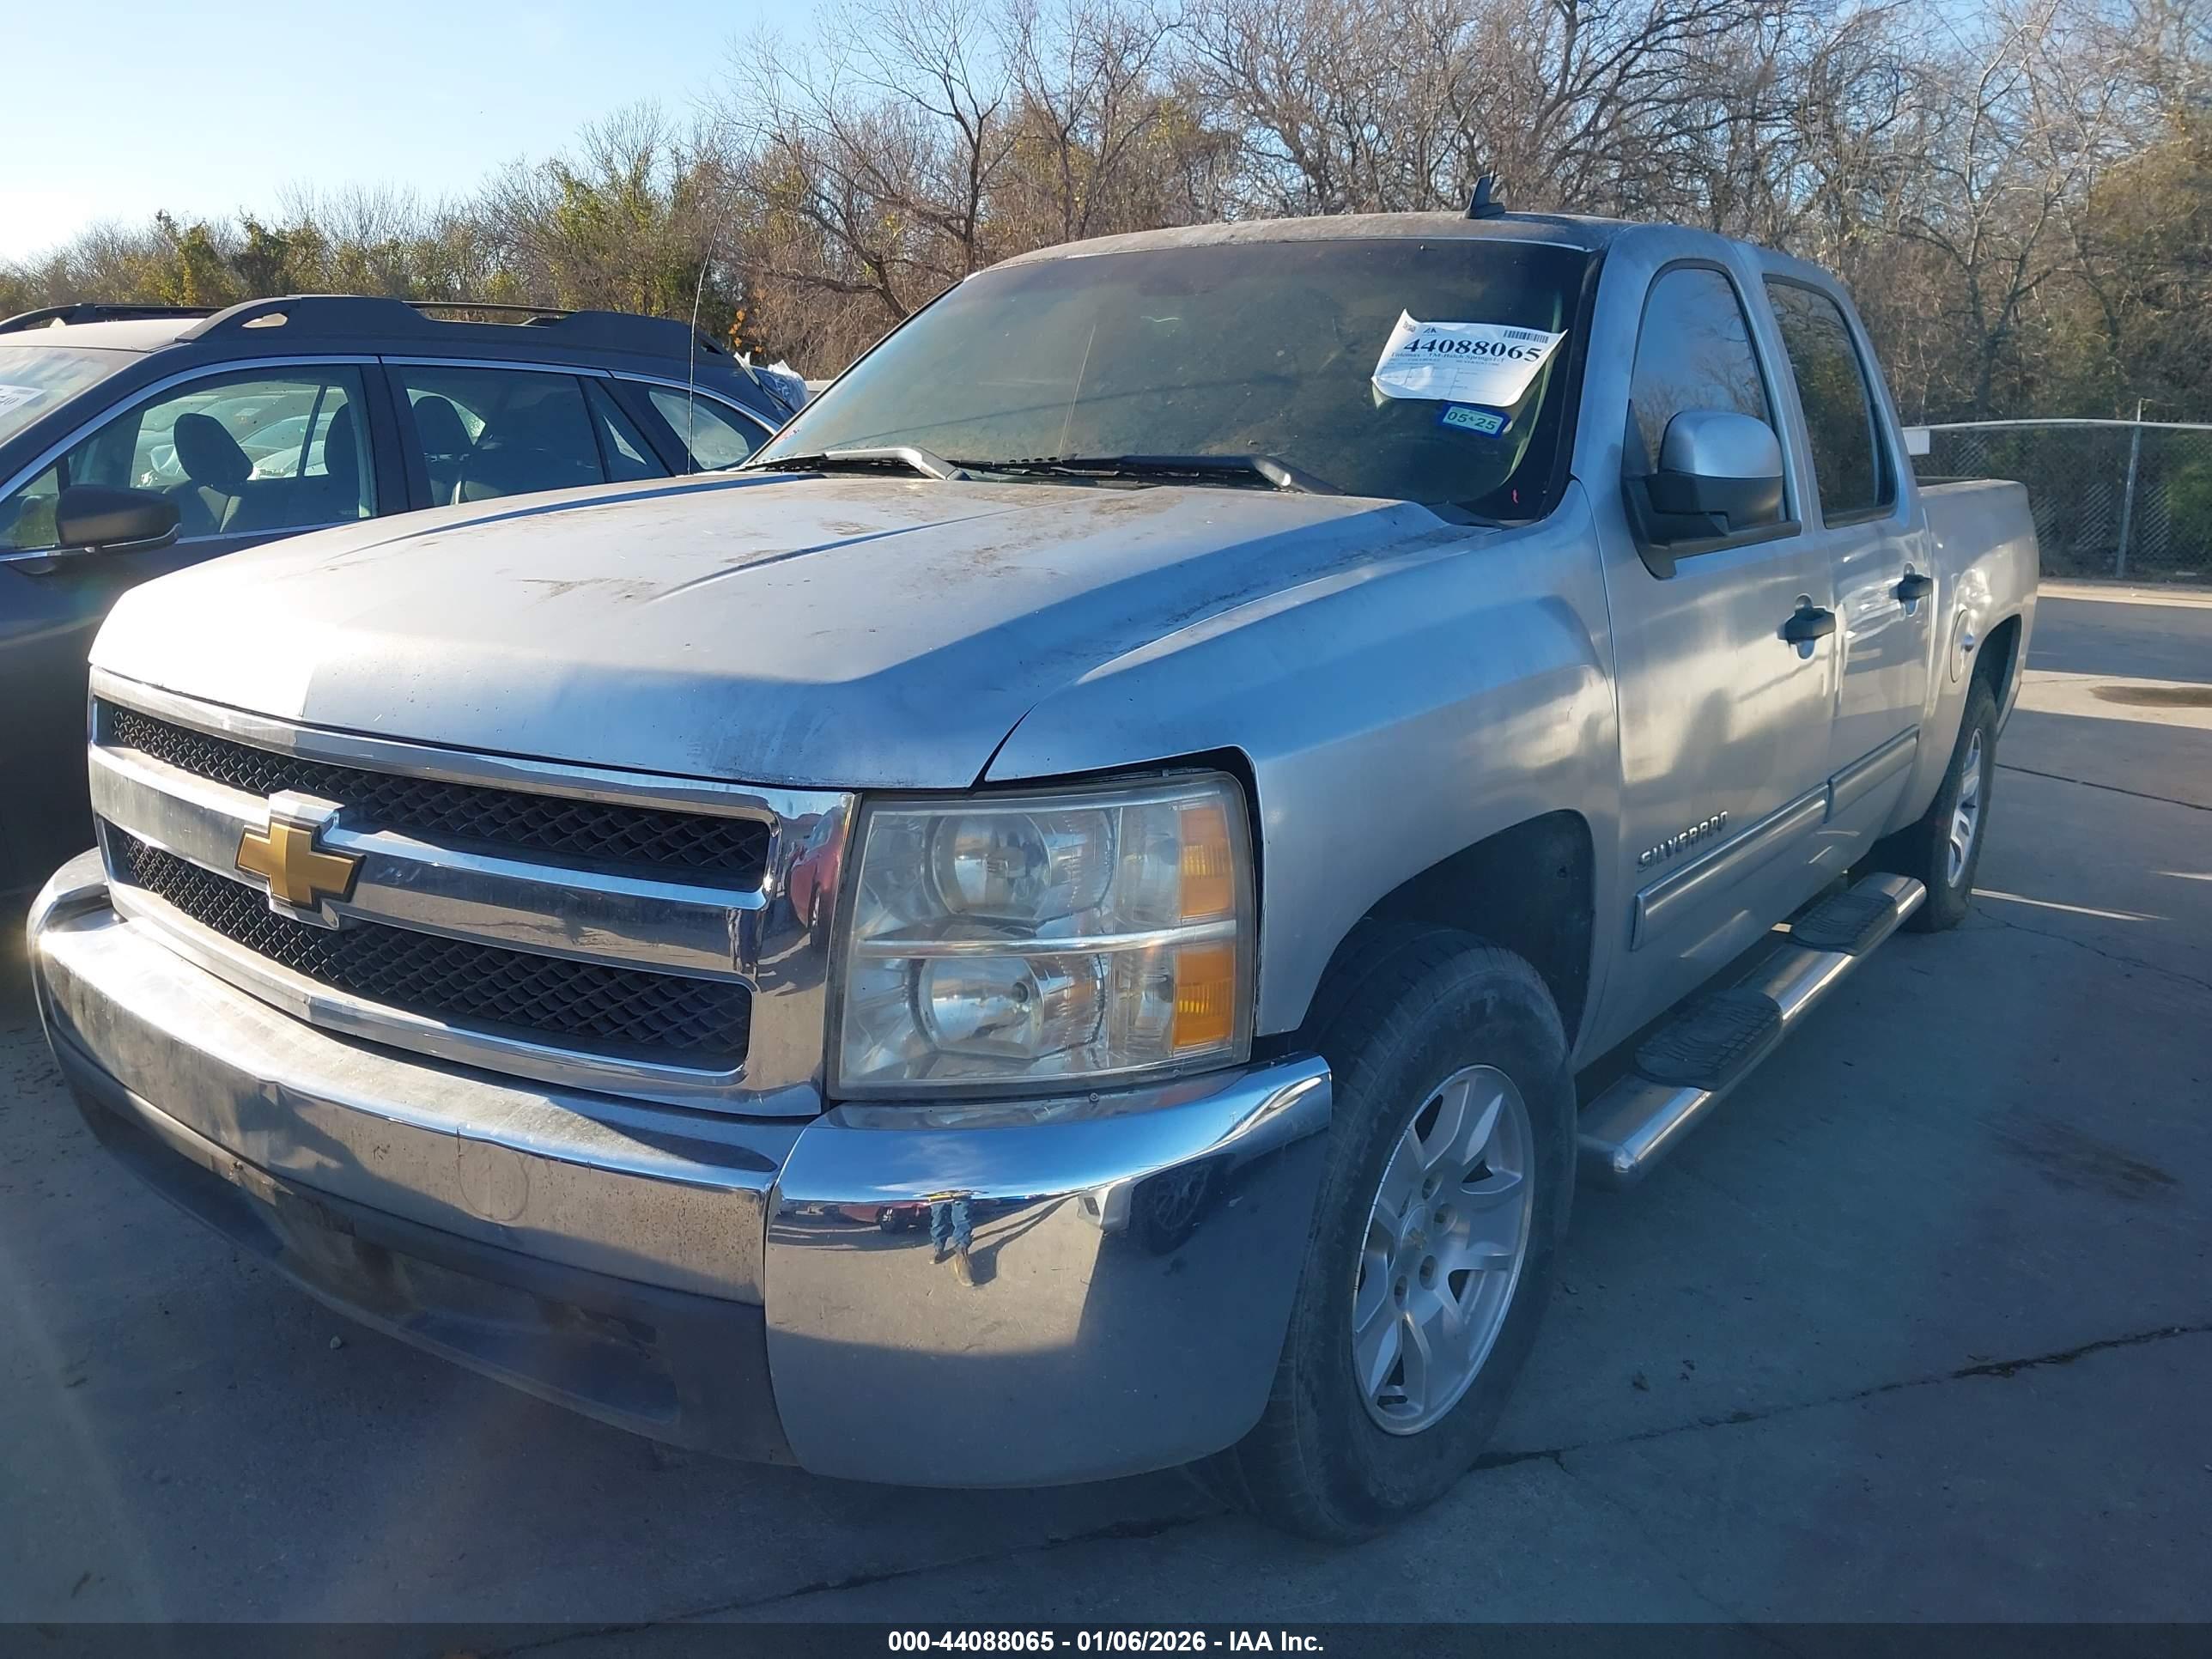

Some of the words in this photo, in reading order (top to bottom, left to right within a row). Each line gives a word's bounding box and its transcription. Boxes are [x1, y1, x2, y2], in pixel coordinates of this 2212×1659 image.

[1404, 338, 1543, 362] 44088065
[1448, 410, 1468, 424] 05
[1474, 417, 1498, 430] 25
[1637, 811, 1729, 872] SILVERADO
